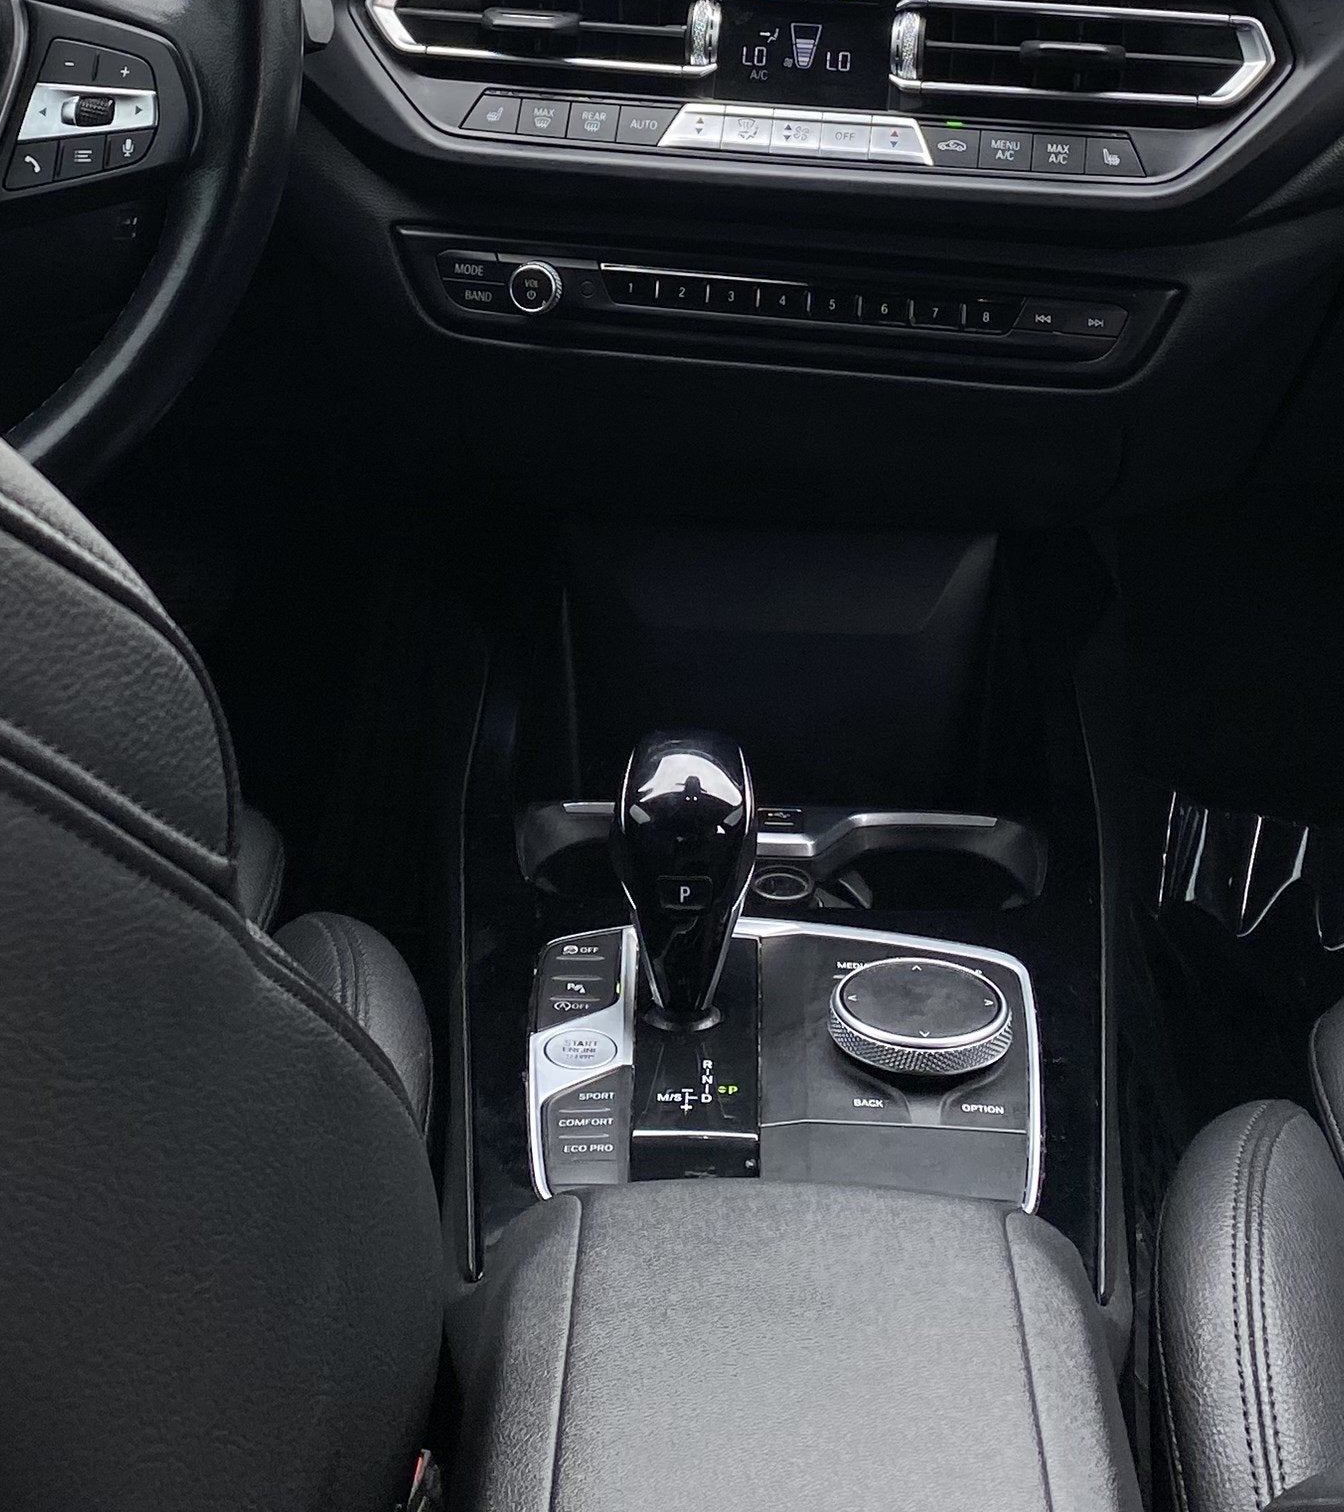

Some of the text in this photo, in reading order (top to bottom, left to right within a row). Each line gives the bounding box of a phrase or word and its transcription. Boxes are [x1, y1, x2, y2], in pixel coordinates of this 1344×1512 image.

[749, 69, 769, 81] A/C
[533, 107, 555, 118] MAX
[581, 110, 607, 121] REAR
[629, 118, 658, 130] AUTO
[834, 131, 856, 142] OFF
[990, 139, 1021, 151] MENU
[1046, 143, 1070, 154] MAX
[995, 149, 1015, 161] A/C
[1048, 153, 1068, 165] A/C
[454, 262, 484, 277] MODE
[523, 278, 539, 289] VOL
[464, 289, 493, 303] BAND
[627, 282, 990, 323] 1 2 3 4 5 6 7 8
[679, 885, 691, 903] P
[579, 946, 599, 954] OFF
[571, 1002, 590, 1010] OFF
[702, 1059, 713, 1069] R
[701, 1075, 714, 1084] N
[728, 1085, 739, 1094] P
[578, 1091, 616, 1101] SPORT
[656, 1093, 683, 1102] M/S
[701, 1094, 713, 1103] D
[853, 1098, 885, 1109] BACK
[961, 1103, 1005, 1115] OPTION
[558, 1117, 615, 1128] COMFORT
[563, 1143, 615, 1154] ECO PRO
